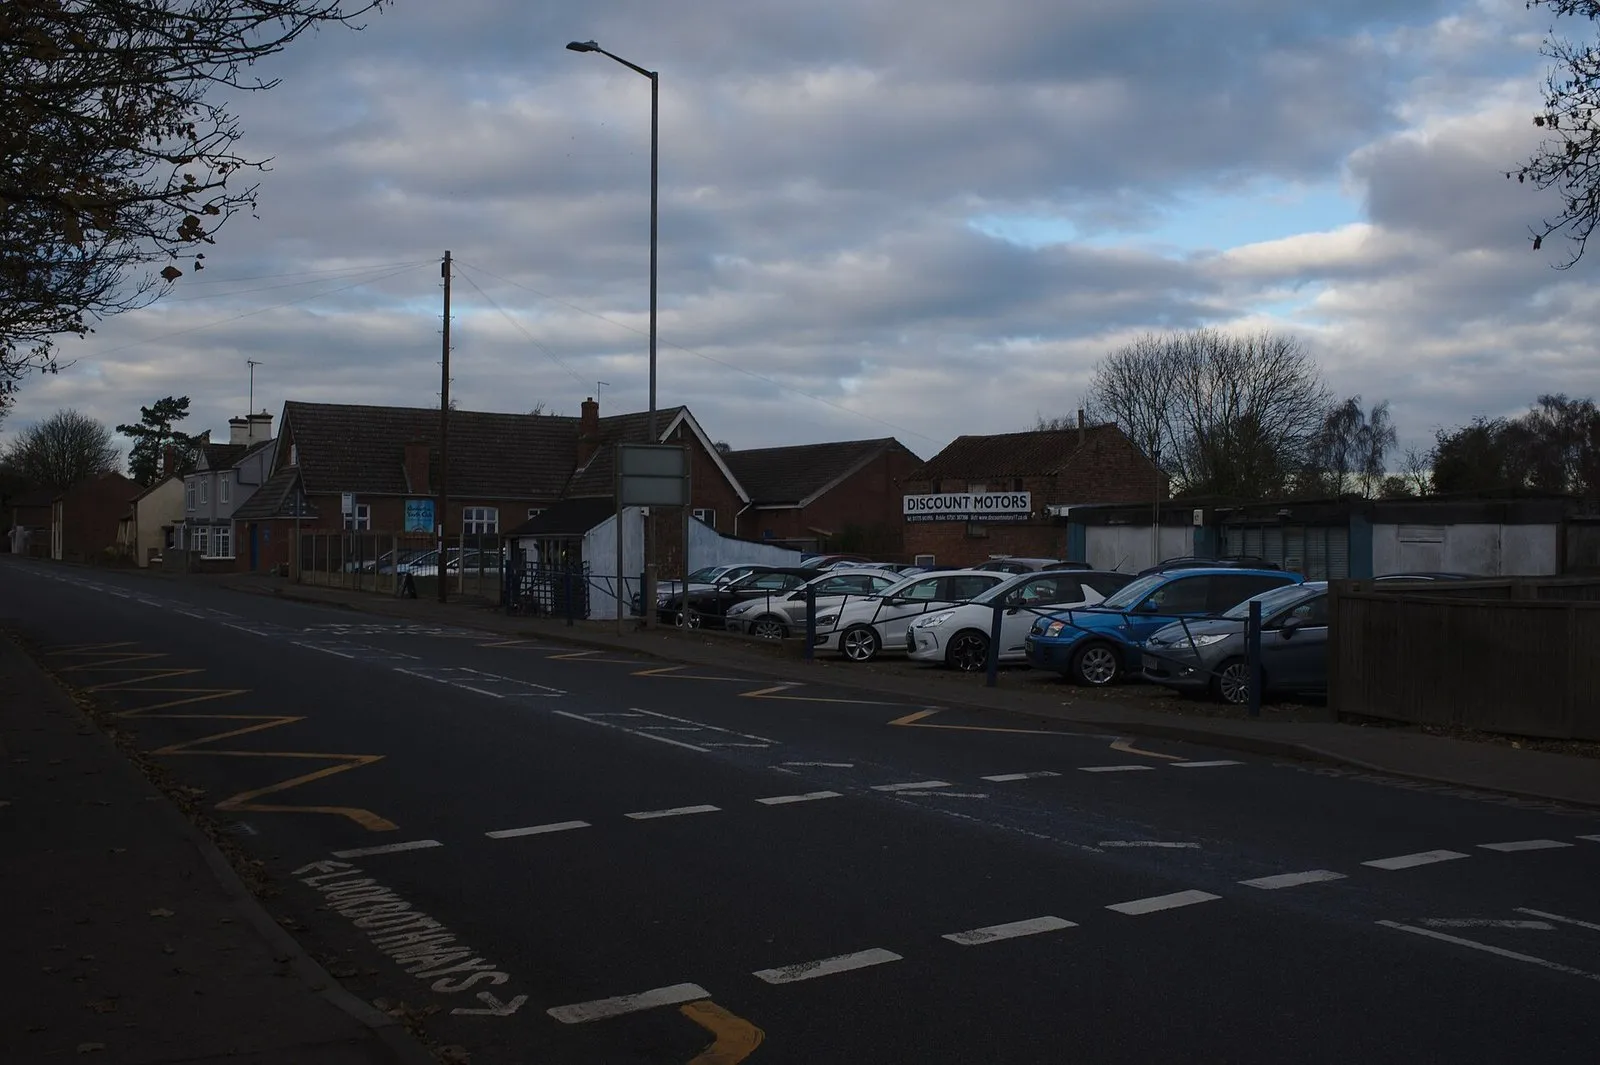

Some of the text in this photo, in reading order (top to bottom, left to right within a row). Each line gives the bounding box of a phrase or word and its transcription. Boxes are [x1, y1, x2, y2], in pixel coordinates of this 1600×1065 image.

[907, 495, 1027, 510] DISCOUNT MOTORS
[382, 936, 510, 993] WAYS
